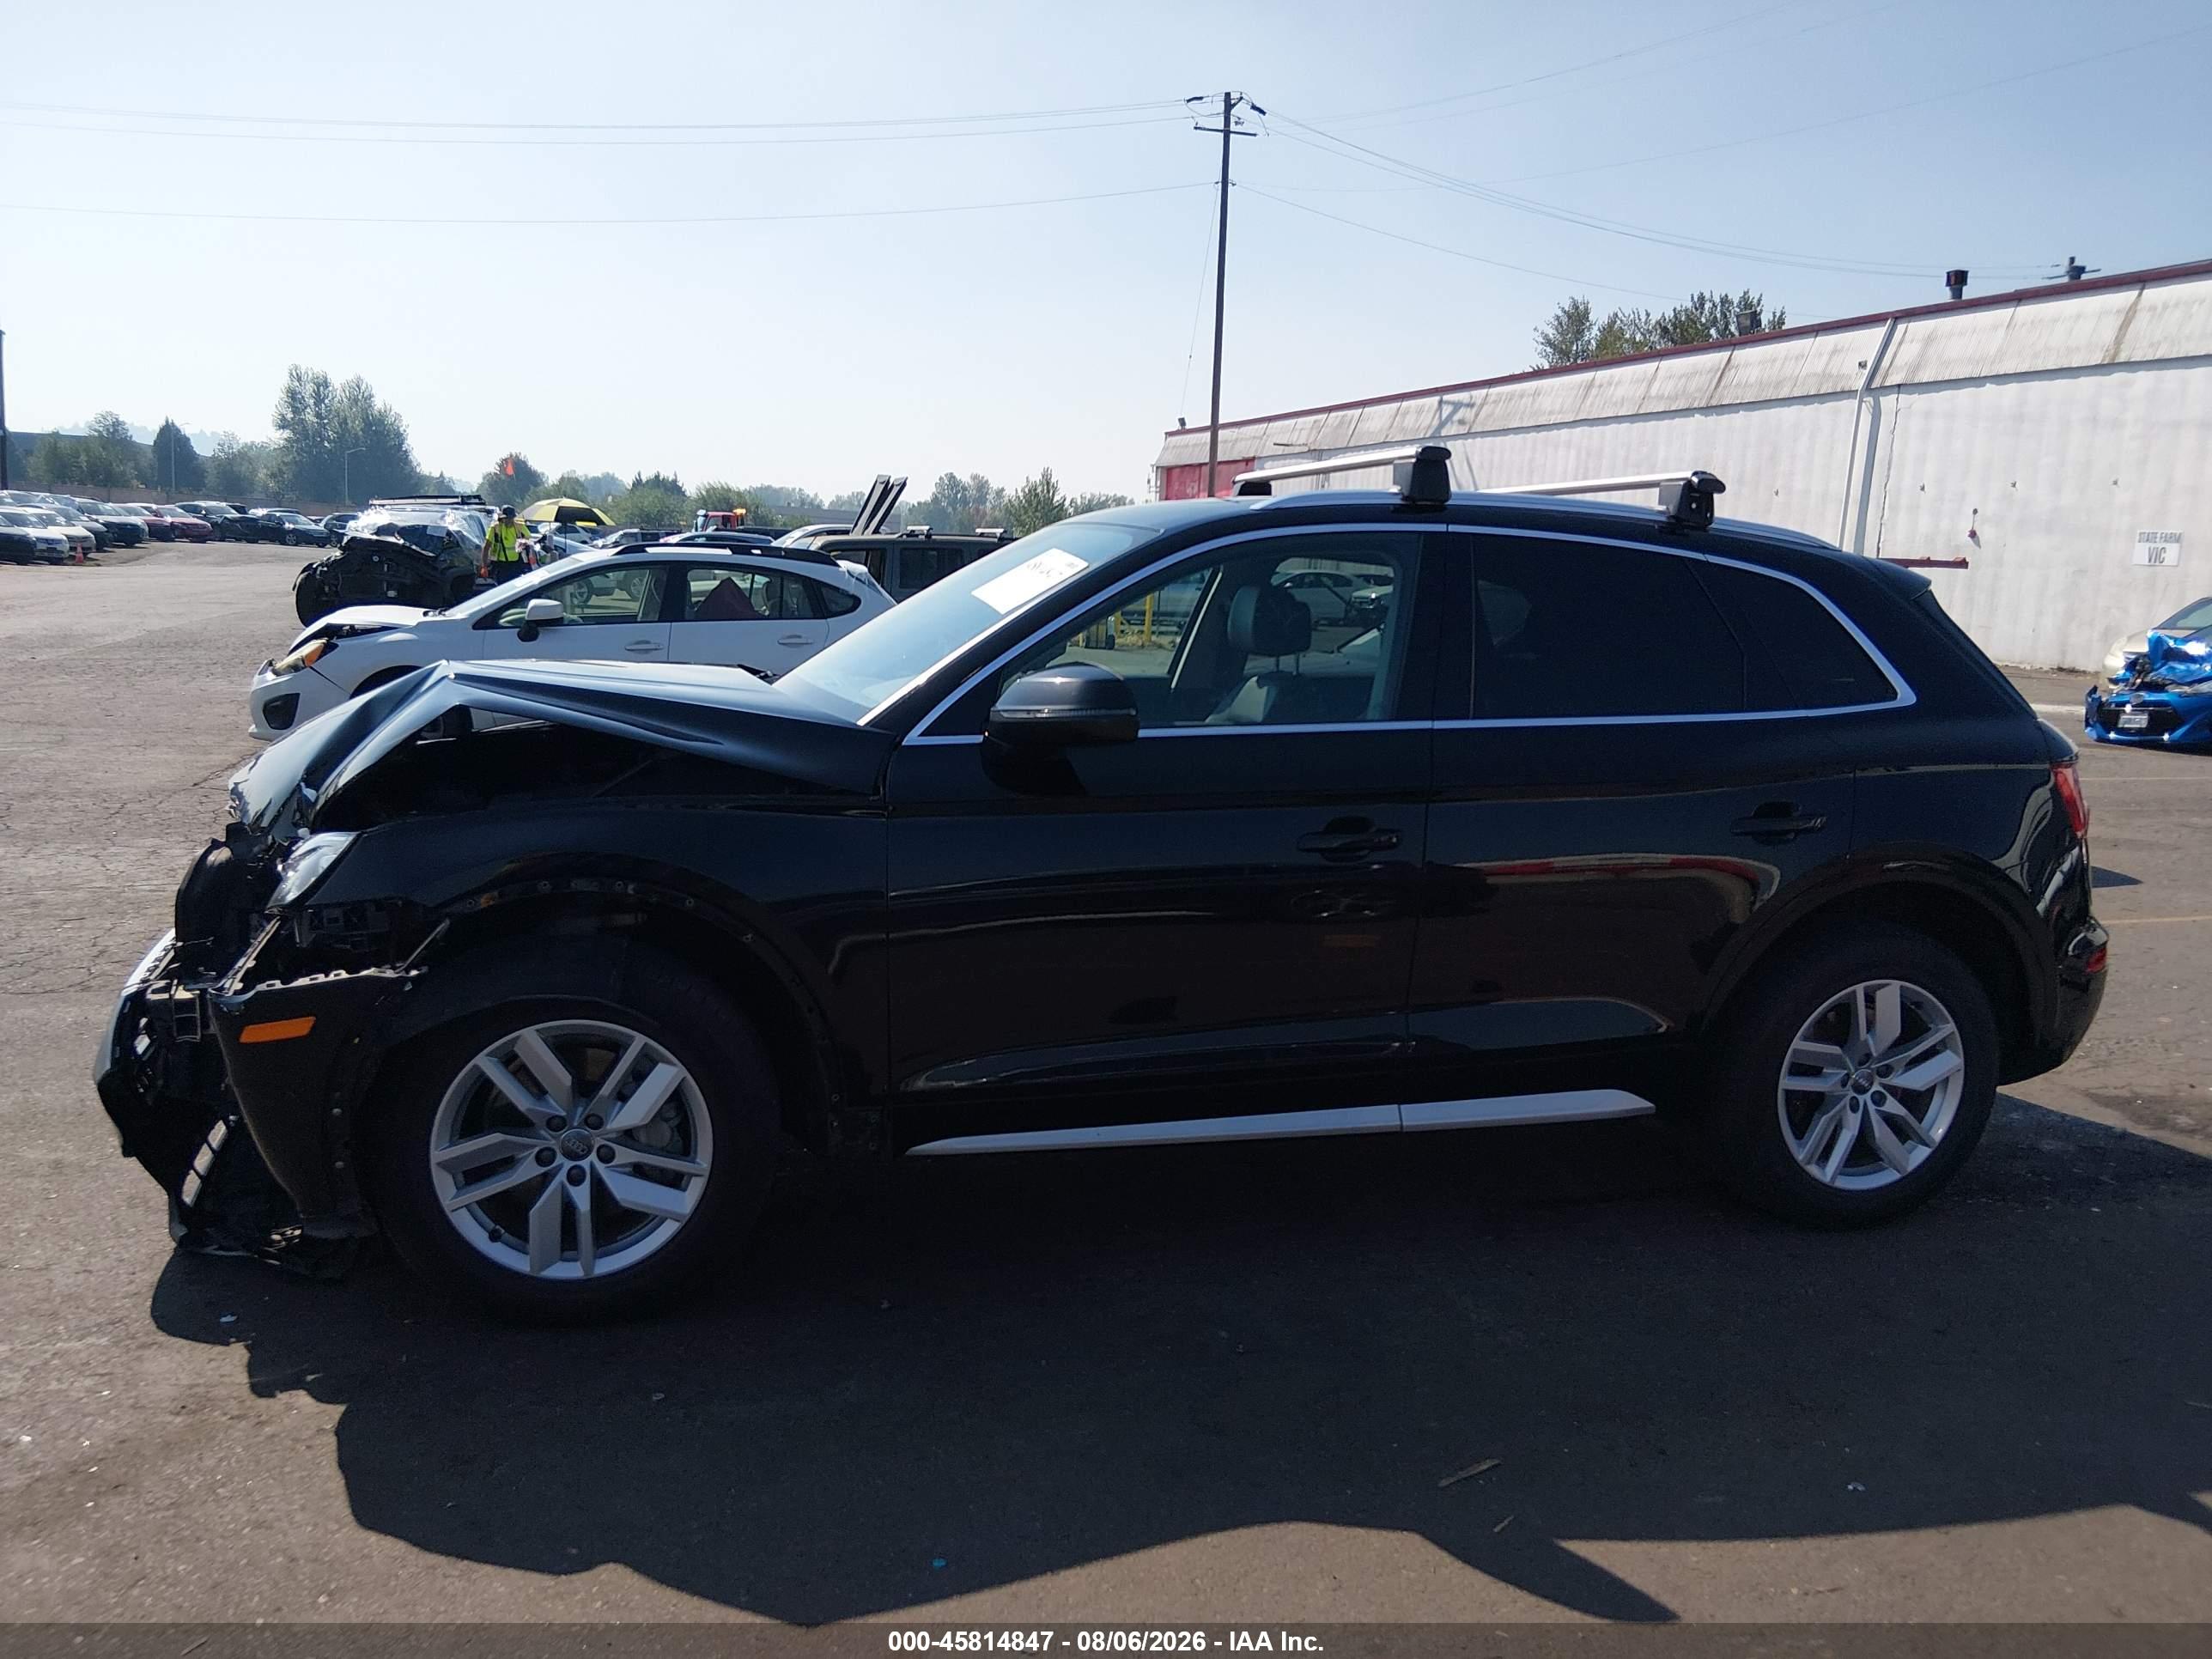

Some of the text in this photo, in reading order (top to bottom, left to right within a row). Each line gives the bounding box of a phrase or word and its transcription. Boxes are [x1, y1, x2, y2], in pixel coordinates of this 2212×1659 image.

[2138, 532, 2181, 543] STATE FARM
[2148, 546, 2166, 563] VIC
